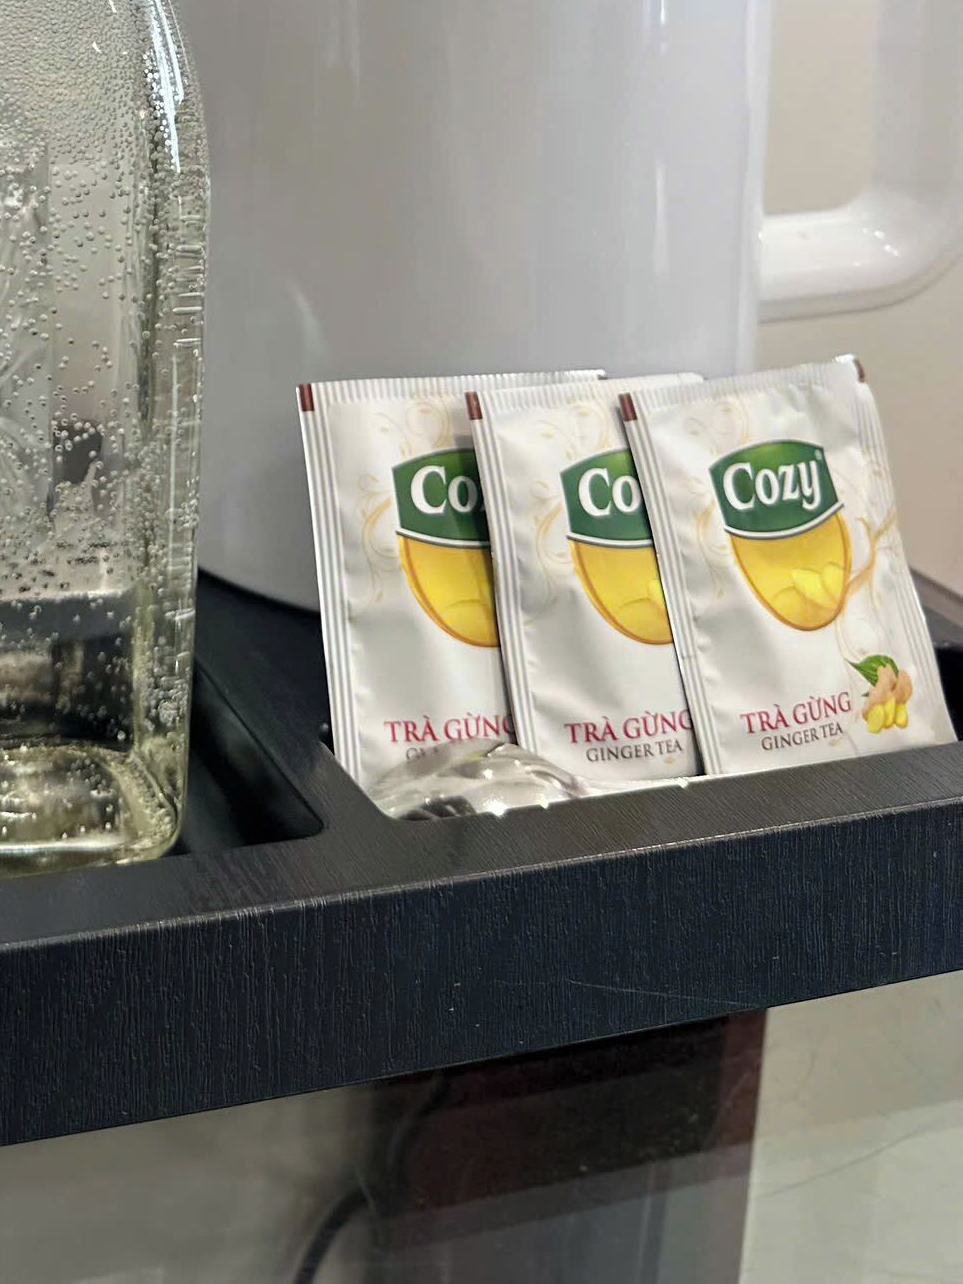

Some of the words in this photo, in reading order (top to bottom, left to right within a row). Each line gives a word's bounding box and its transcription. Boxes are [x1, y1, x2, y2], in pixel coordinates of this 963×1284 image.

[410, 465, 484, 514] Co
[723, 460, 821, 510] Cozy
[384, 715, 439, 742] TRÀ
[564, 716, 619, 743] TRÀ
[738, 704, 790, 733] TRÀ
[761, 728, 819, 750] GINGER
[820, 722, 843, 737] TEA
[585, 742, 654, 762] GINGER
[655, 739, 683, 755] TEA
